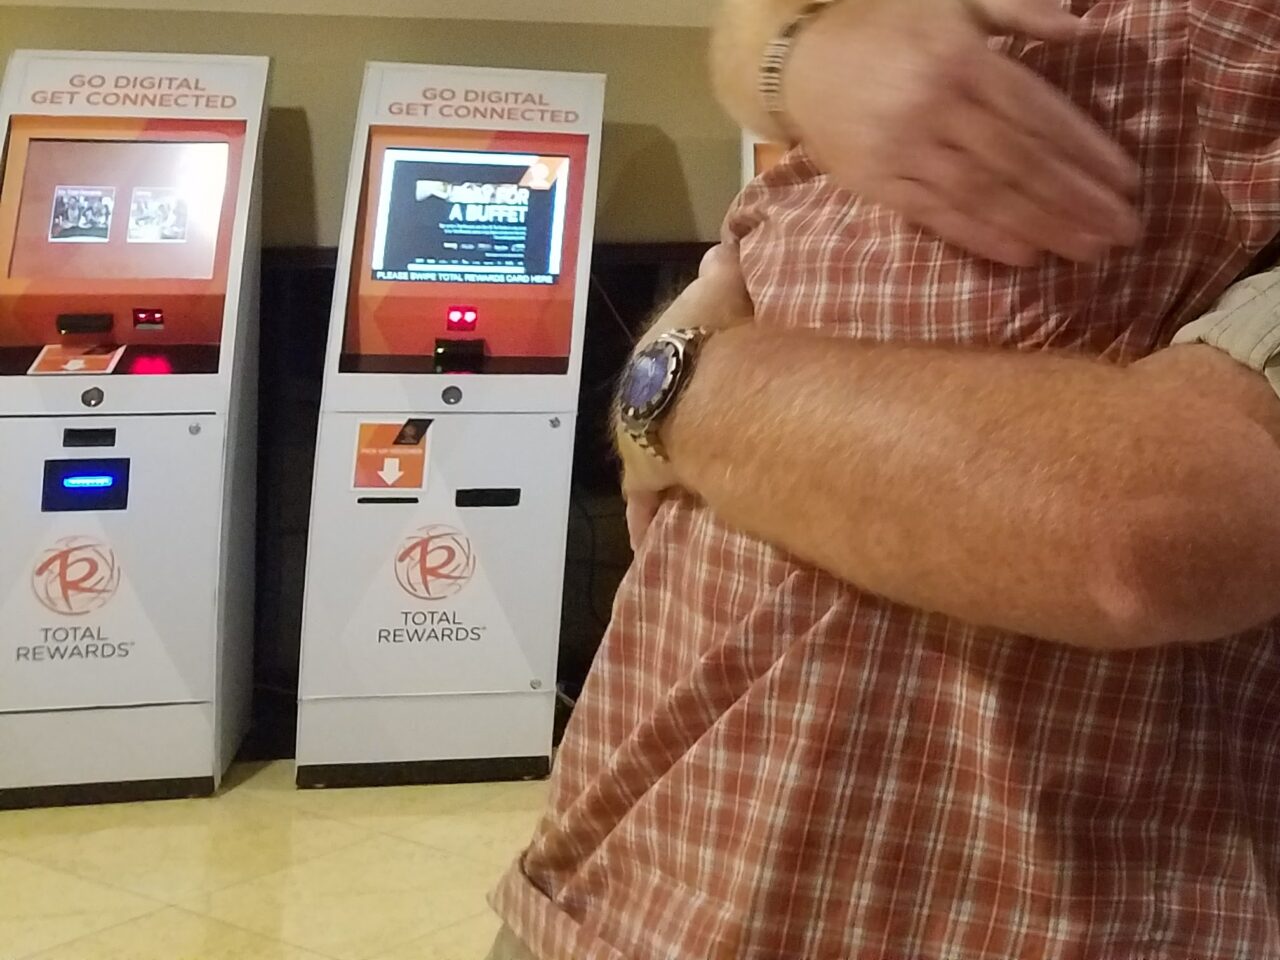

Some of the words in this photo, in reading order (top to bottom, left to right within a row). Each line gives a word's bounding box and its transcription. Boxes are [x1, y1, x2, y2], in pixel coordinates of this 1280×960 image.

[69, 74, 106, 89] GO
[114, 75, 206, 91] DIGITAL
[31, 90, 80, 105] GET
[85, 91, 237, 109] CONNECTED
[422, 87, 456, 102] GO
[464, 89, 550, 106] DIGITAL
[388, 102, 432, 117] GET
[438, 104, 580, 123] CONNECTED
[449, 204, 463, 221] A
[466, 204, 529, 223] BUFFET
[376, 271, 409, 281] PLEASE
[438, 273, 463, 282] TOTAL
[506, 274, 530, 283] CARD
[401, 610, 463, 626] TOTAL
[41, 626, 109, 643] TOTAL
[378, 626, 482, 643] REWARDS
[16, 642, 130, 661] REWARDS
